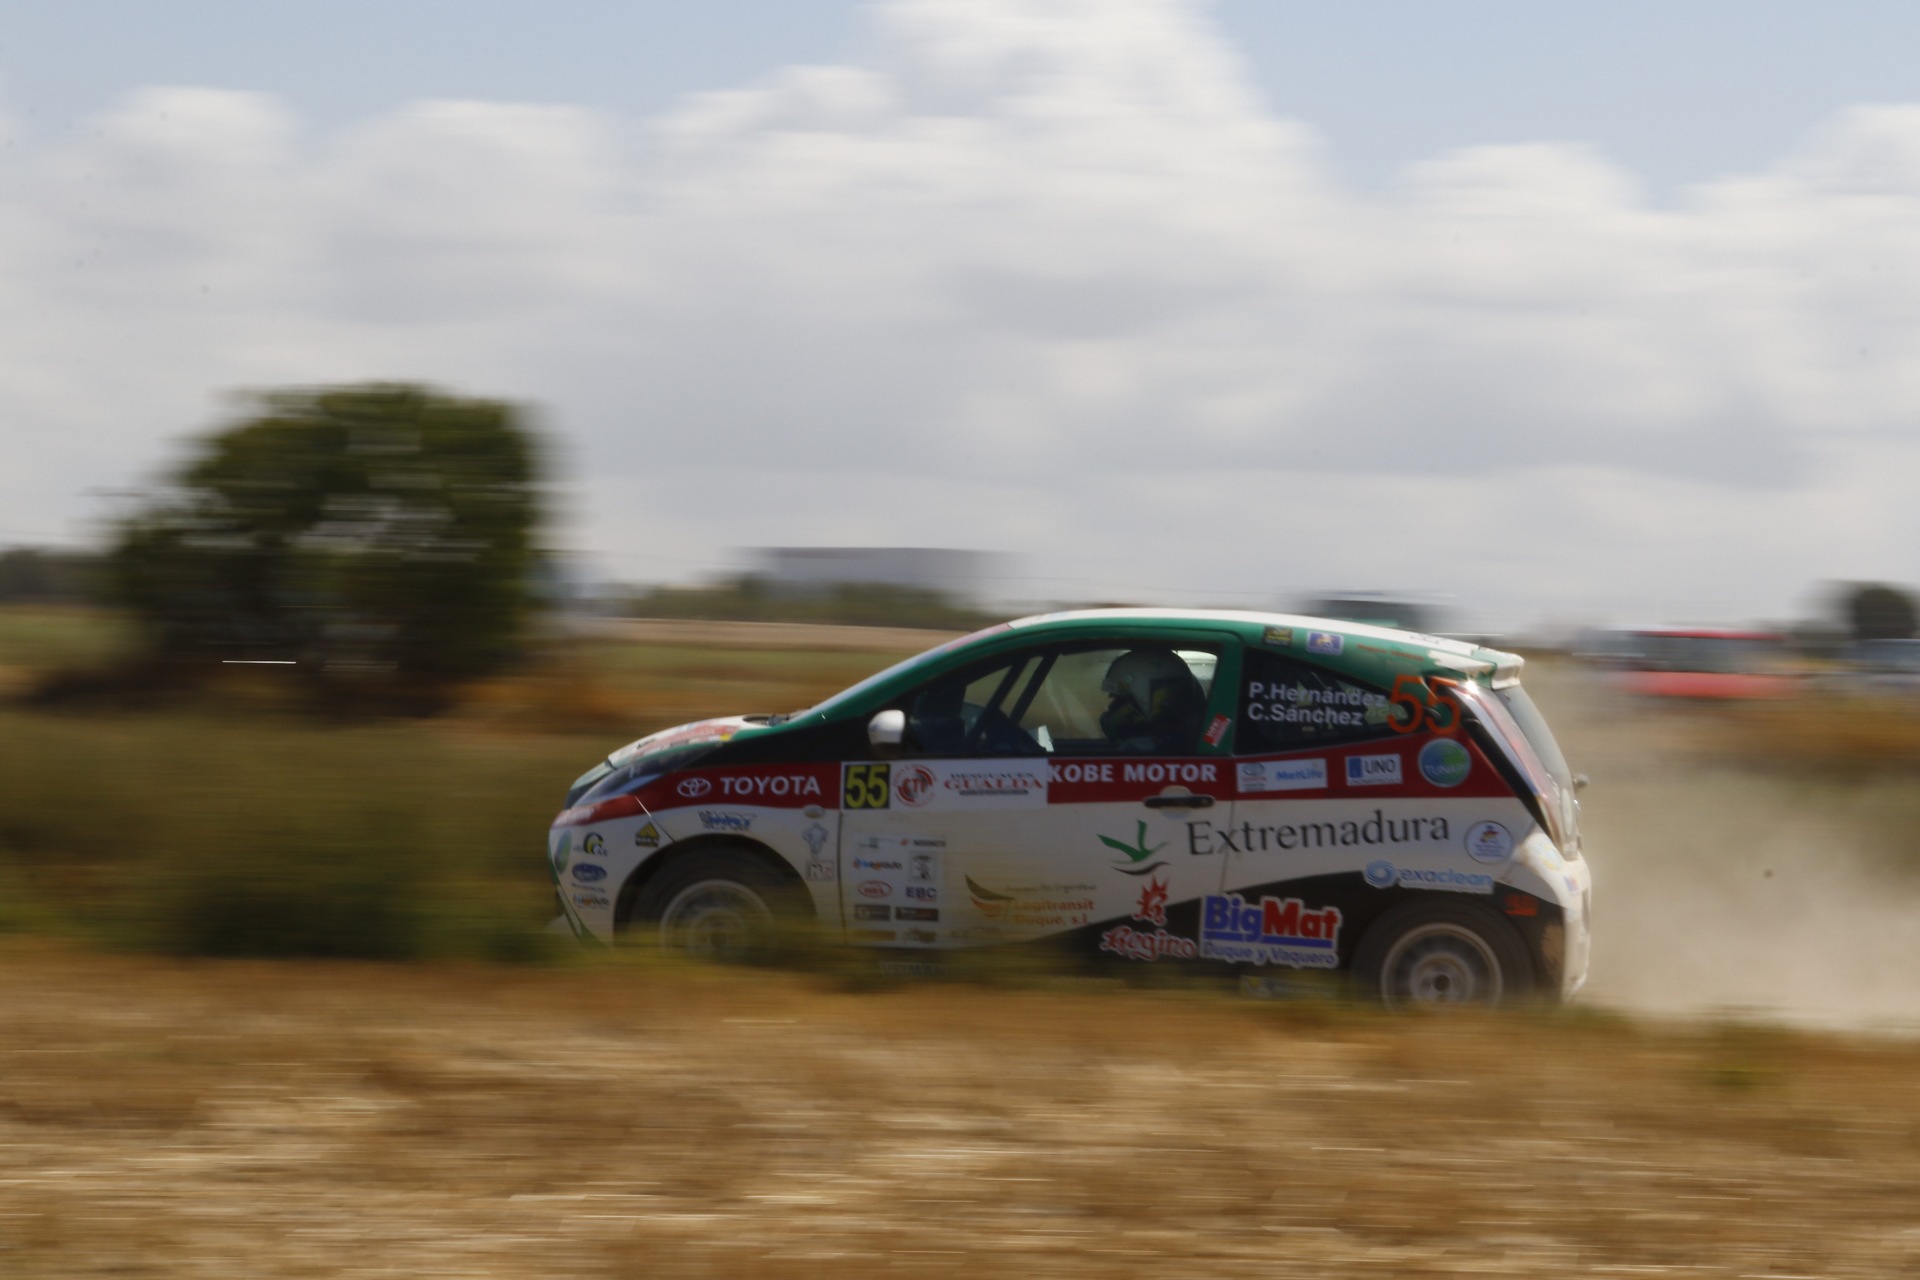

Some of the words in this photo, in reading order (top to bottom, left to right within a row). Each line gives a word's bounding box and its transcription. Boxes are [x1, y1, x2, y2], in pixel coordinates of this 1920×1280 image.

[1247, 702, 1363, 726] C.Sánchez
[1387, 674, 1461, 735] 55
[1048, 764, 1114, 782] KOBE
[1123, 763, 1217, 782] MOTOR
[1364, 759, 1396, 774] UNO
[720, 775, 821, 796] TOYOTA
[845, 765, 889, 809] 55
[1186, 809, 1450, 856] Extremadura
[1400, 868, 1492, 886] exaclean
[905, 886, 937, 898] EBC
[1205, 895, 1338, 942] BigMat
